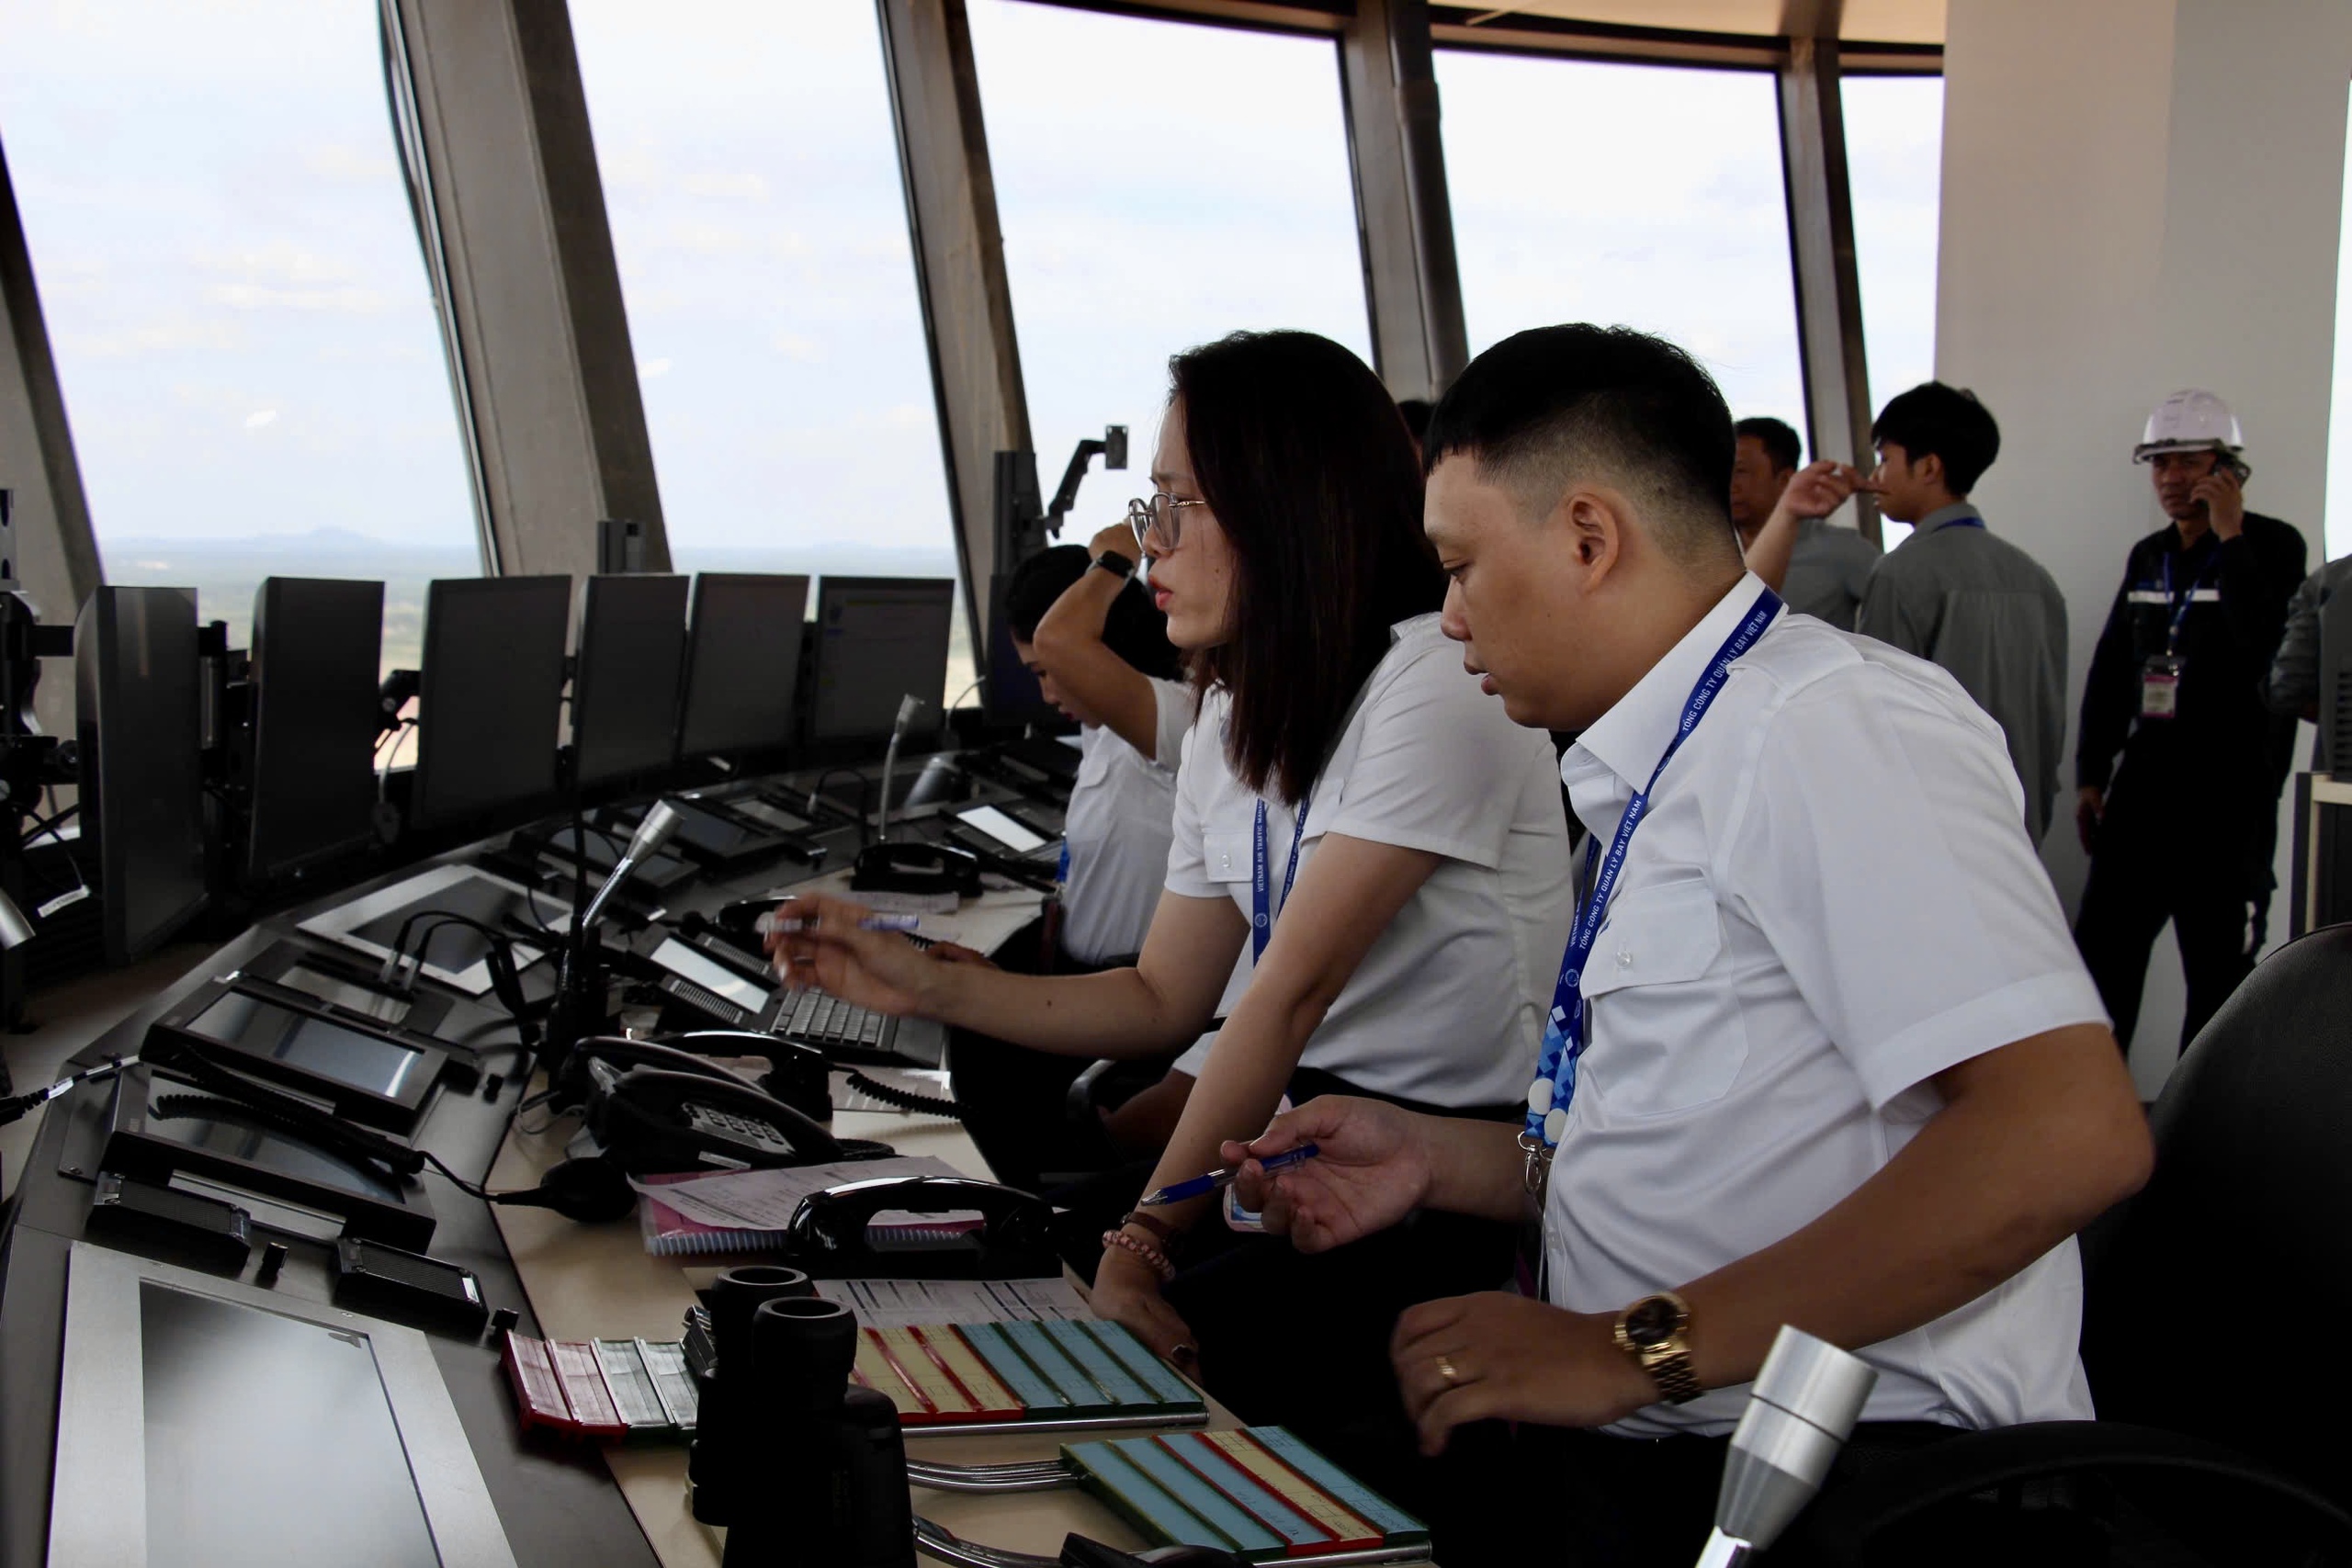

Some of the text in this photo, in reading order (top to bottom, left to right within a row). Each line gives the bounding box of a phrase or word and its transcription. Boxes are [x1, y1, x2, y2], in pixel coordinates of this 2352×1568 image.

[1693, 688, 1711, 710] CÔNG
[1706, 677, 1717, 688] TY
[1735, 634, 1748, 650] BAY
[1755, 610, 1768, 625] NAM
[1587, 905, 1600, 928] CÔNG
[1596, 894, 1605, 904] TY
[1615, 838, 1626, 857] BAY
[1622, 820, 1633, 838] VIỆT
[1629, 800, 1642, 820] NAM
